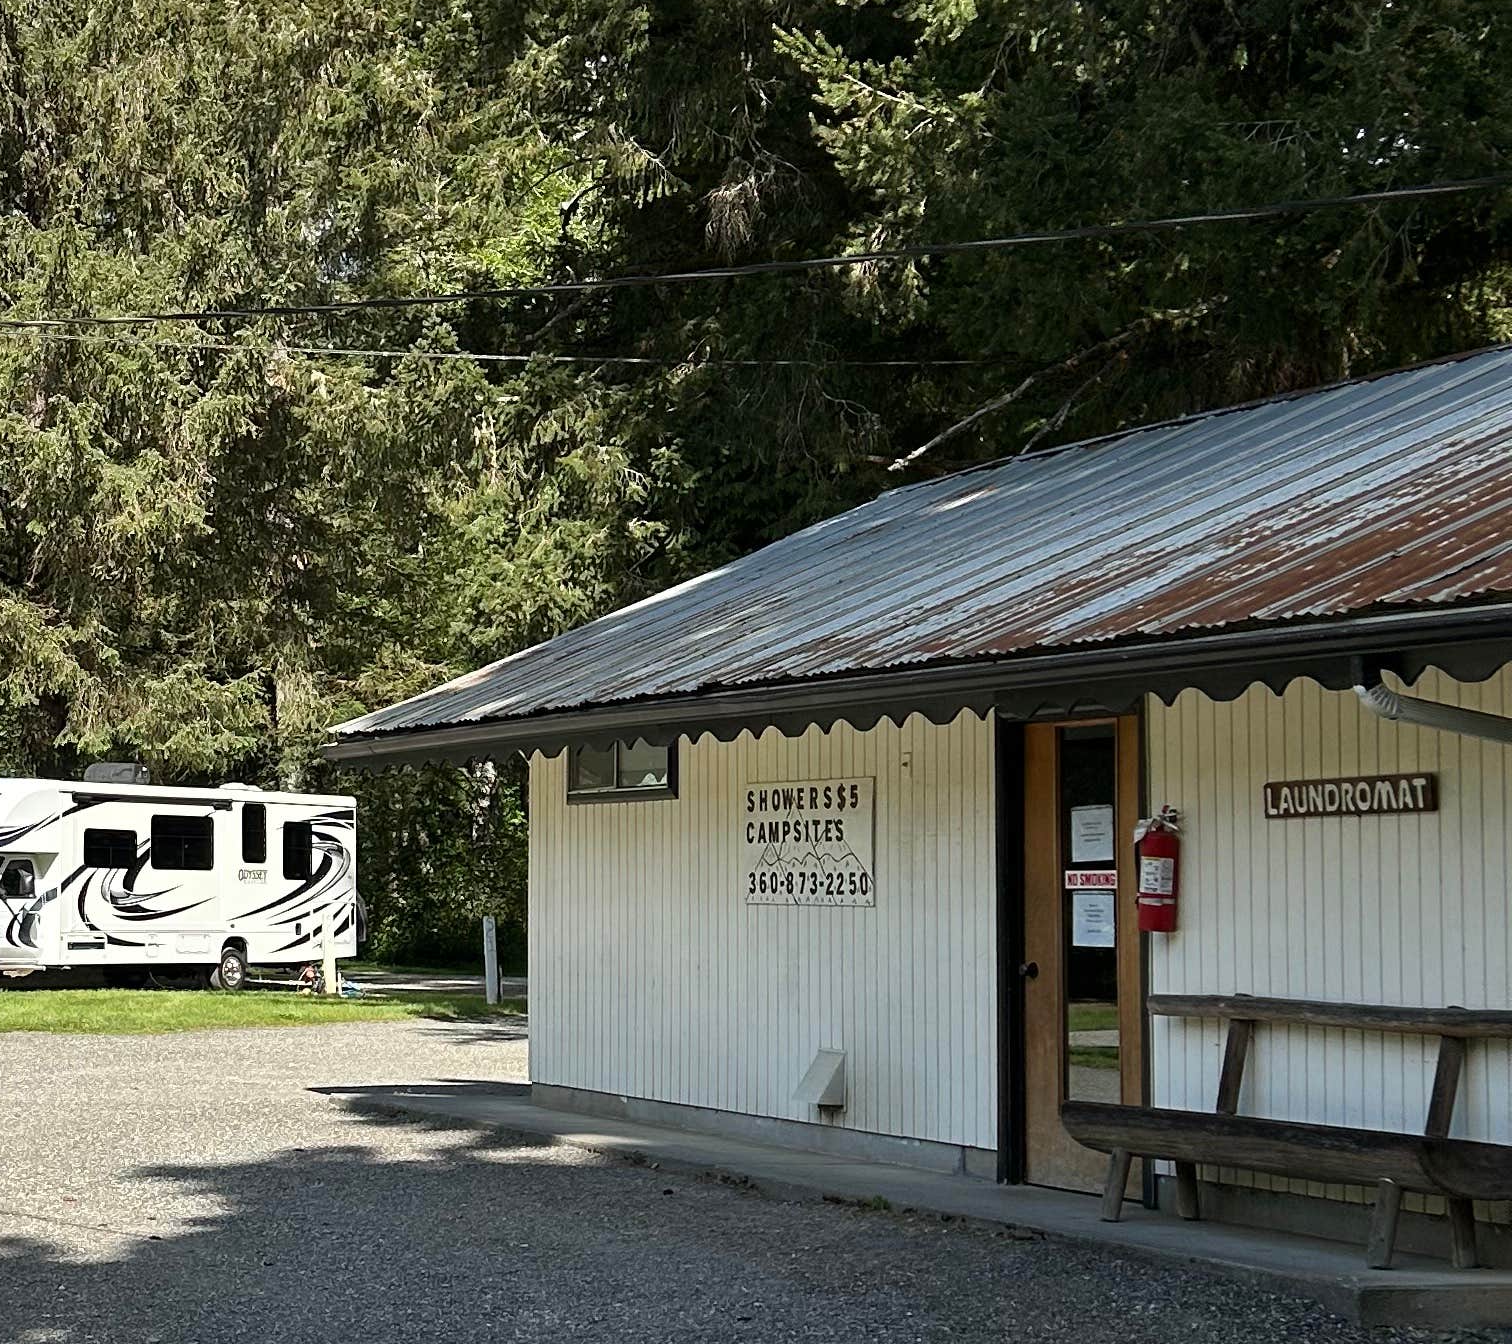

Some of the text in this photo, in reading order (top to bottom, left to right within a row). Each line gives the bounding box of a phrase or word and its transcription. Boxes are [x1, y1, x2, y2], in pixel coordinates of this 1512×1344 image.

[746, 786, 833, 812] SHOWERS
[1266, 777, 1427, 816] LAUNDROMAT
[746, 819, 844, 844] CAMPSITES
[1067, 873, 1116, 886] NO SMOKING
